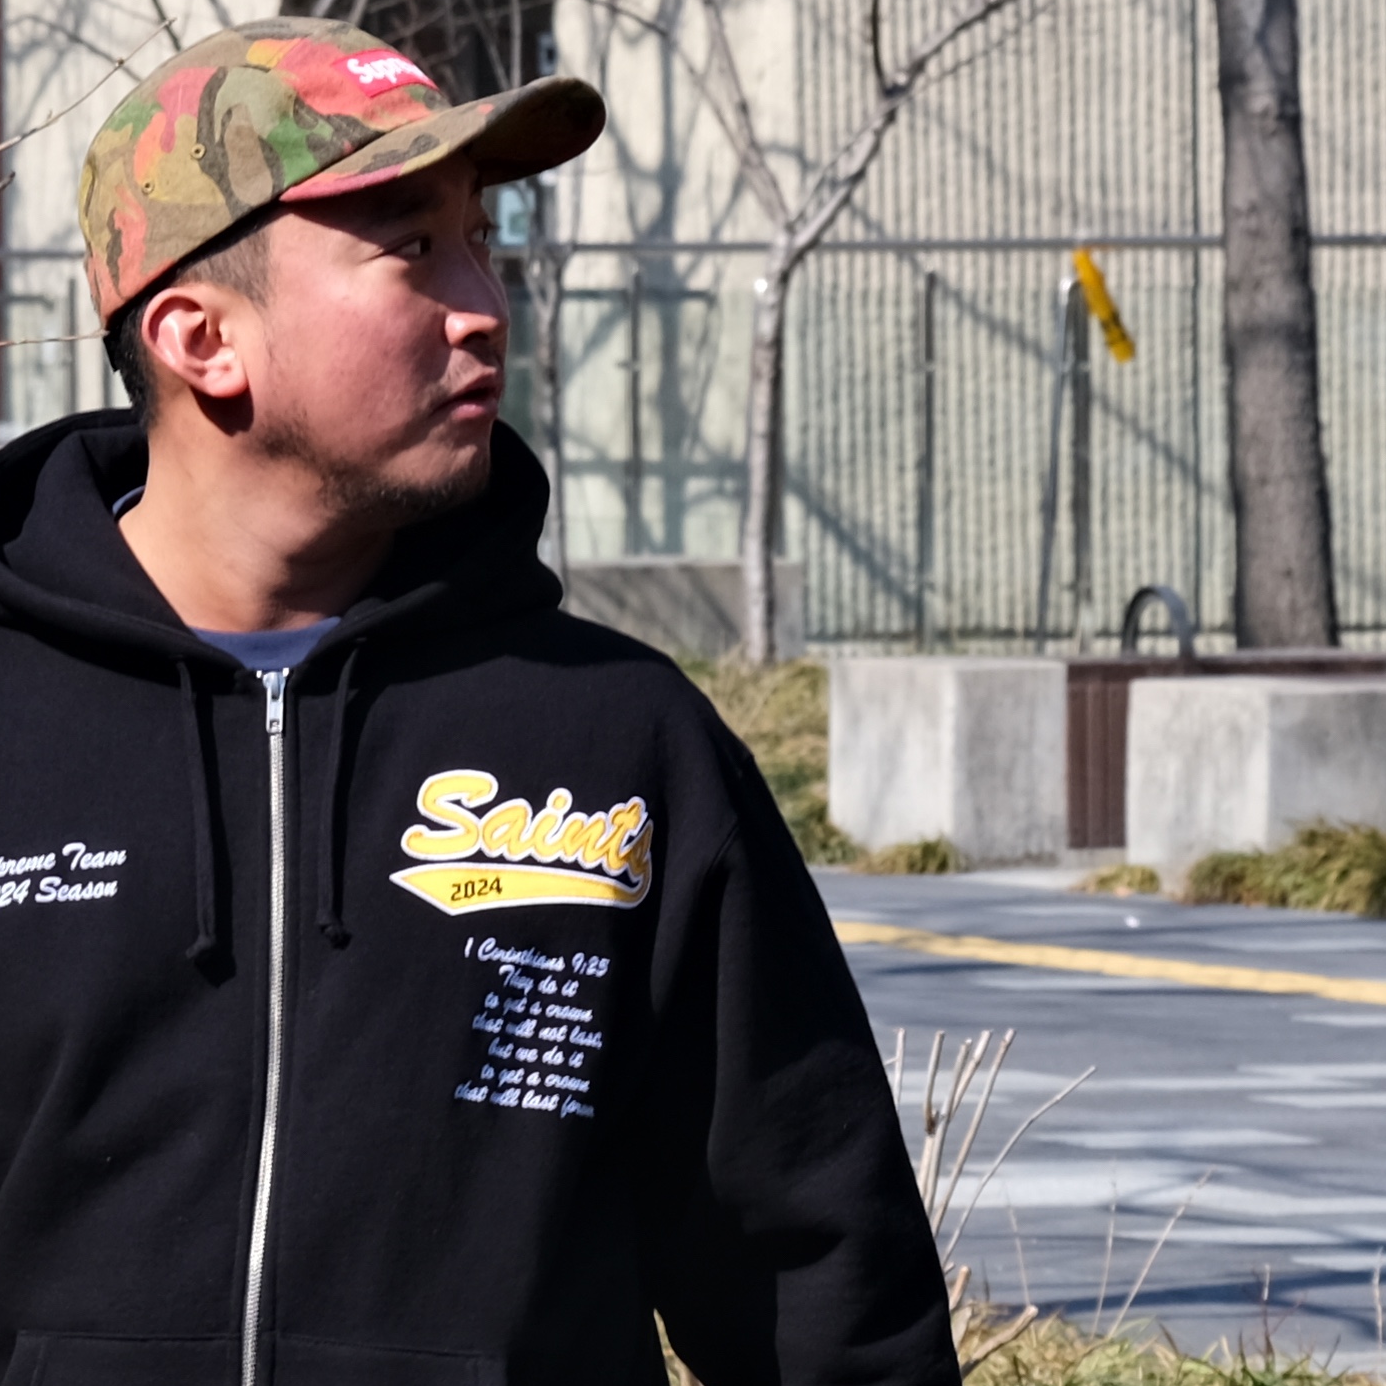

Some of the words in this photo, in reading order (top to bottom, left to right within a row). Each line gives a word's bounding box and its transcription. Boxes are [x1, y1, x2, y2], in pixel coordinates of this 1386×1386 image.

[62, 841, 127, 871] Team
[34, 876, 118, 903] Season
[450, 876, 503, 901] 2024
[477, 937, 566, 972] Corinthians
[499, 964, 534, 995] They
[537, 975, 558, 994] do
[561, 979, 579, 997] it
[484, 992, 500, 1009] to
[502, 997, 528, 1016] get
[529, 1001, 542, 1016] a
[545, 1004, 593, 1022] crown
[472, 1011, 504, 1033] that
[505, 1018, 537, 1038] will
[538, 1025, 568, 1043] not
[488, 1037, 514, 1059] but
[515, 1047, 539, 1063] we
[542, 1045, 565, 1065] do
[568, 1050, 585, 1068] it
[480, 1063, 495, 1080] to
[498, 1067, 525, 1087] get
[526, 1071, 541, 1087] a
[544, 1073, 591, 1093] crown
[454, 1080, 489, 1103] that
[521, 1089, 560, 1111] last
